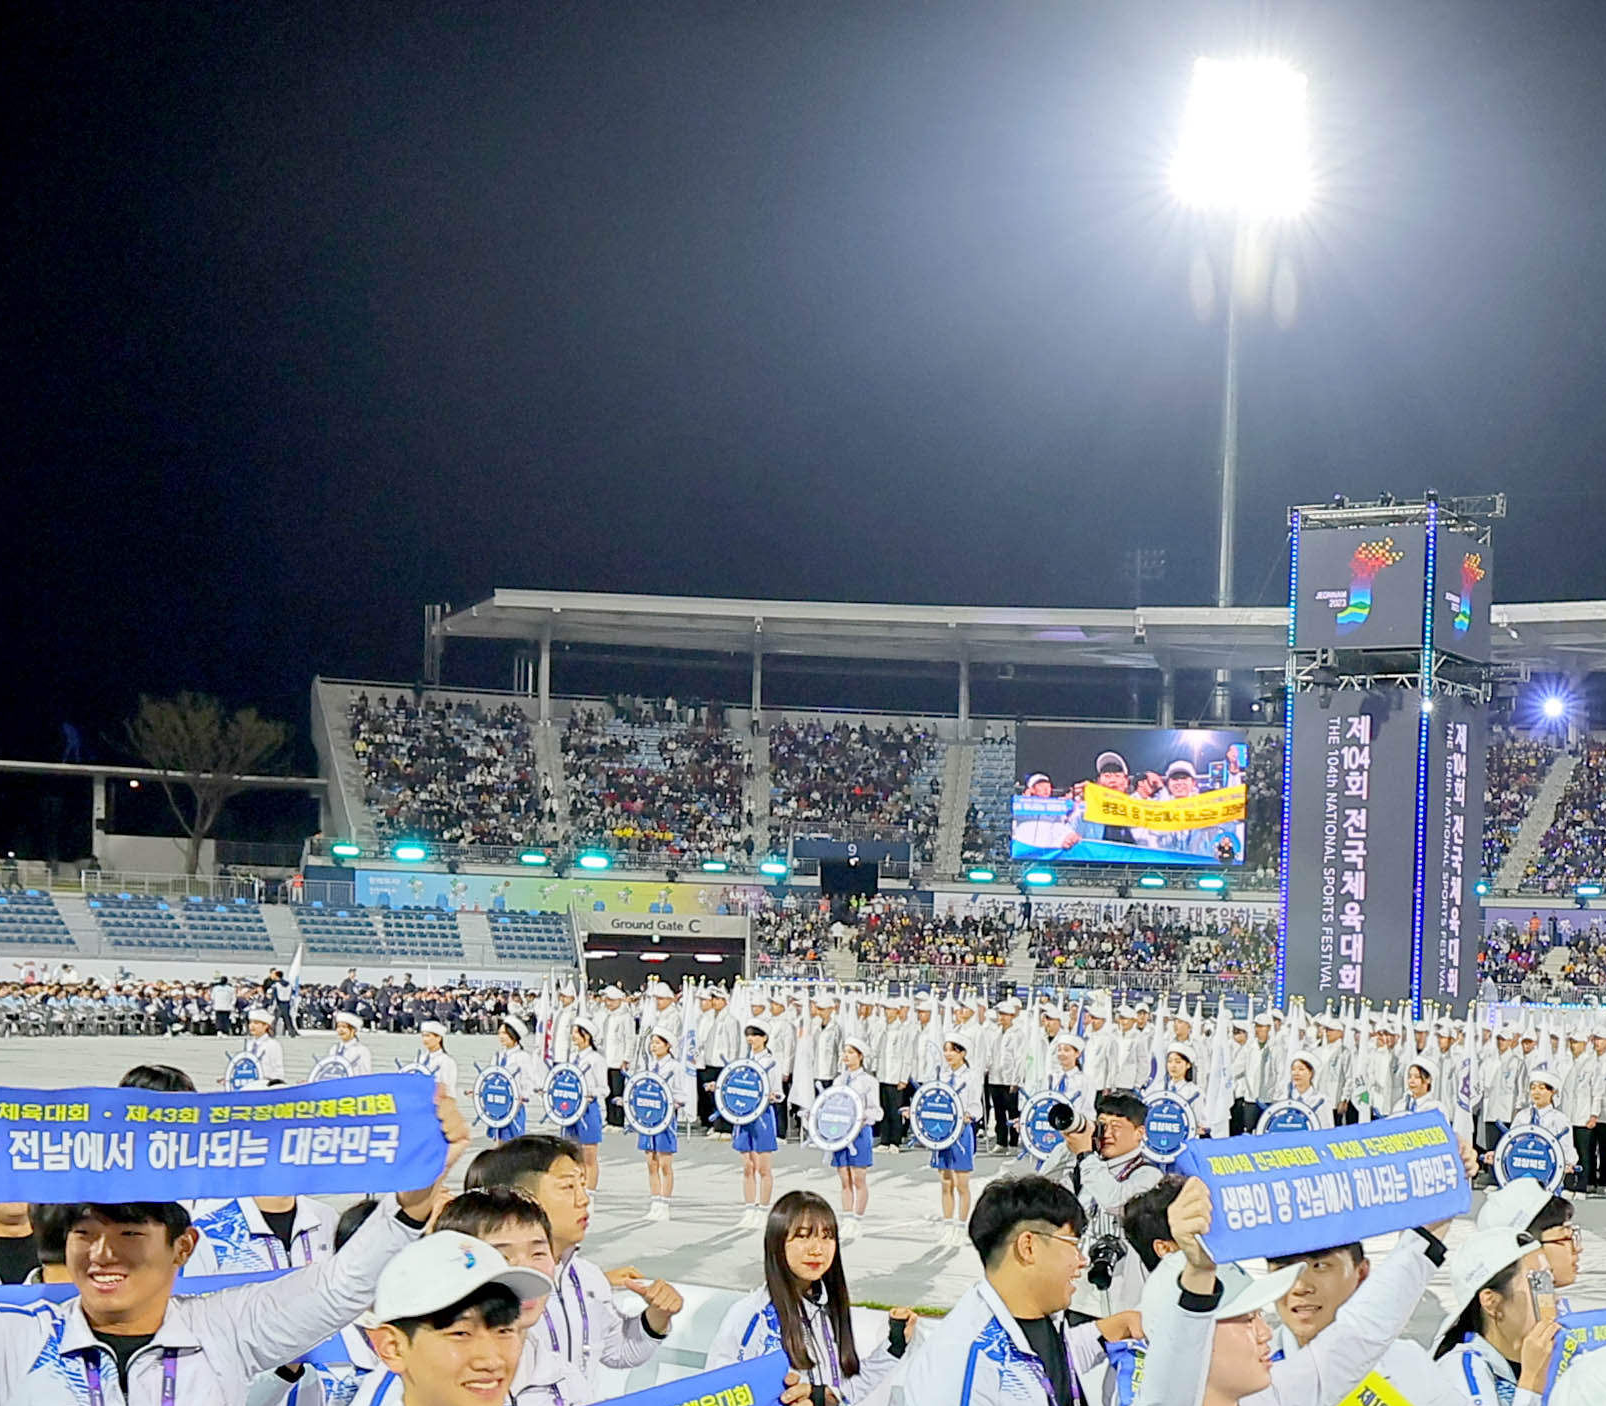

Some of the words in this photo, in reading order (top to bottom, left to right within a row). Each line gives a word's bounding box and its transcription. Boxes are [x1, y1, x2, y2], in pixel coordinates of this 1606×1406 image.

[1327, 716, 1341, 745] THE
[1326, 750, 1340, 788] 104th
[1341, 715, 1372, 800] 제104회
[847, 843, 858, 857] 9
[1322, 792, 1338, 863] NATIONAL
[1321, 867, 1336, 923] SPORTS
[1337, 808, 1368, 994] 전국체육대회
[611, 917, 654, 931] Ground
[657, 919, 685, 932] Gate
[688, 919, 701, 933] C
[1319, 926, 1334, 991] FESTIVAL
[124, 1104, 200, 1124] 제43회
[208, 1093, 397, 1123] 전국장애인체육대회
[8, 1130, 135, 1172] 전남에서
[148, 1128, 269, 1169] 하나되는
[280, 1124, 400, 1166] 대한민국
[1220, 1182, 1274, 1231] 생명의
[1271, 1179, 1293, 1223] 땅
[1292, 1170, 1355, 1220] 전남에서
[1352, 1164, 1409, 1208] 하나되는
[1406, 1154, 1459, 1198] 대한민국
